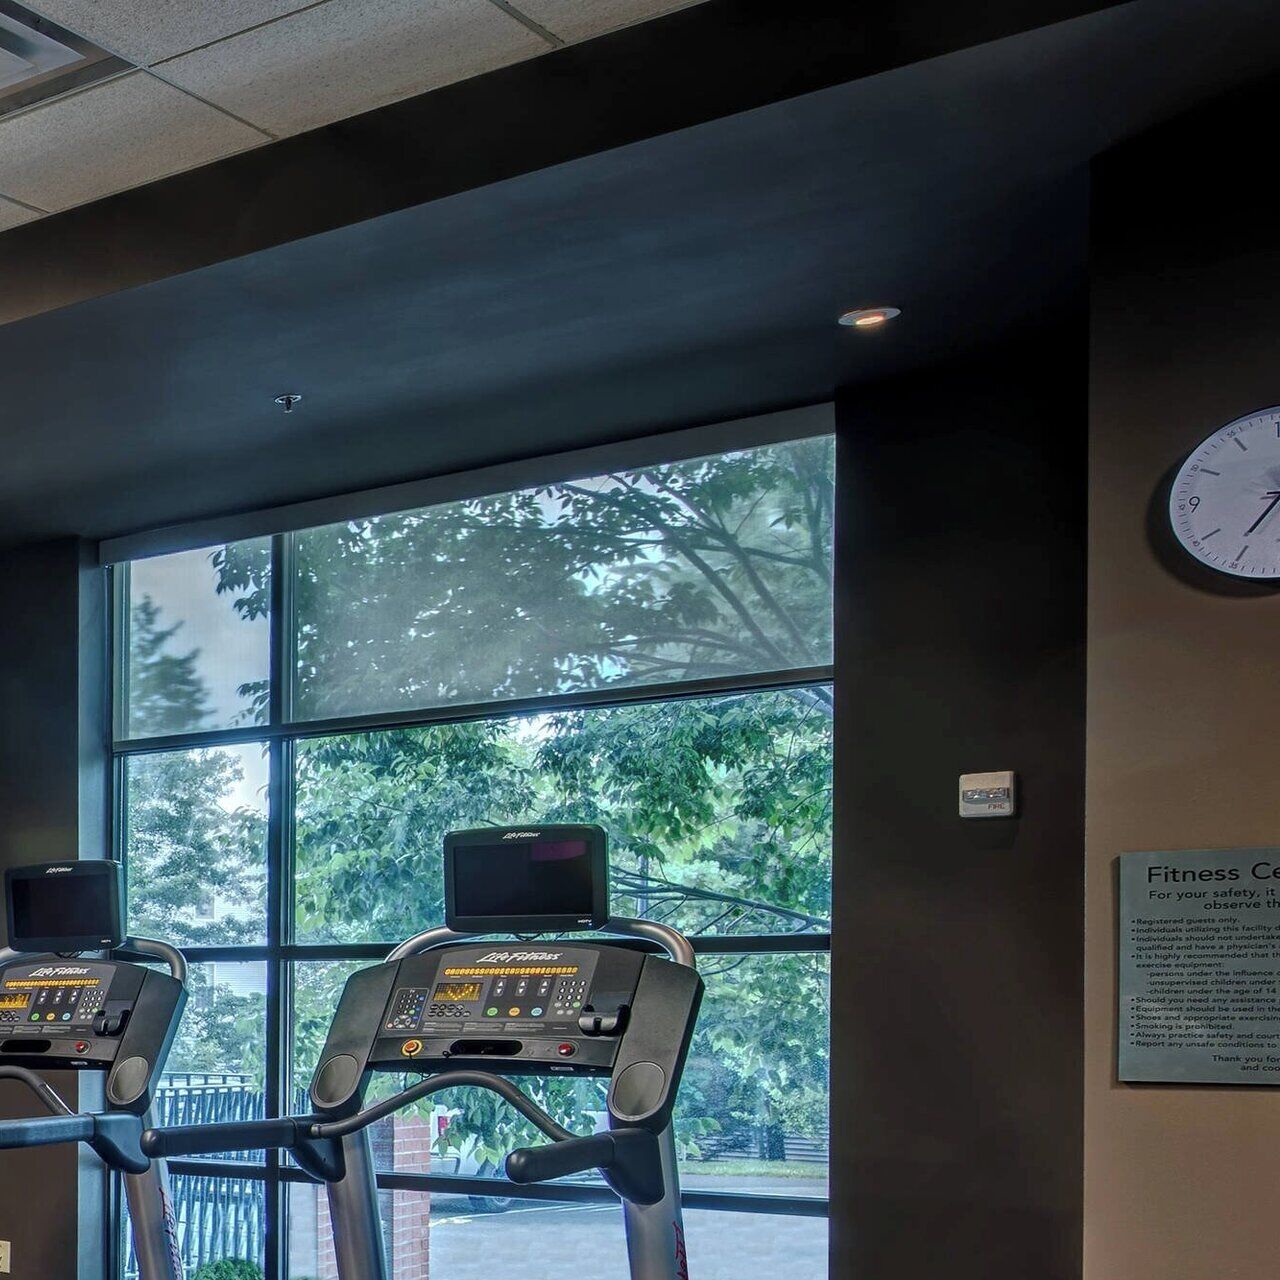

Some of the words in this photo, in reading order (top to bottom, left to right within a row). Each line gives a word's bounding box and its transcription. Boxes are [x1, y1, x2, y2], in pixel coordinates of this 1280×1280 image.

[1188, 496, 1201, 513] 9
[1148, 866, 1240, 883] Fitness
[1149, 890, 1172, 900] For
[1177, 891, 1207, 901] your
[1213, 887, 1260, 899] safety,
[1266, 887, 1275, 896] it
[1203, 899, 1261, 910] observe
[1136, 918, 1183, 926] Registered
[1185, 934, 1214, 942] should
[1136, 944, 1174, 952] qualified
[1195, 943, 1216, 951] have
[1226, 943, 1276, 951] physician's
[1154, 953, 1181, 961] highly
[1183, 952, 1248, 960] recommended
[1233, 988, 1250, 996] age
[1136, 996, 1165, 1004] Should
[1183, 1014, 1236, 1022] appropriate
[1206, 1032, 1234, 1040] safety
[1217, 1041, 1264, 1049] conditions
[1212, 1055, 1242, 1063] Thank
[1245, 1056, 1263, 1064] you
[1240, 1064, 1259, 1072] and
